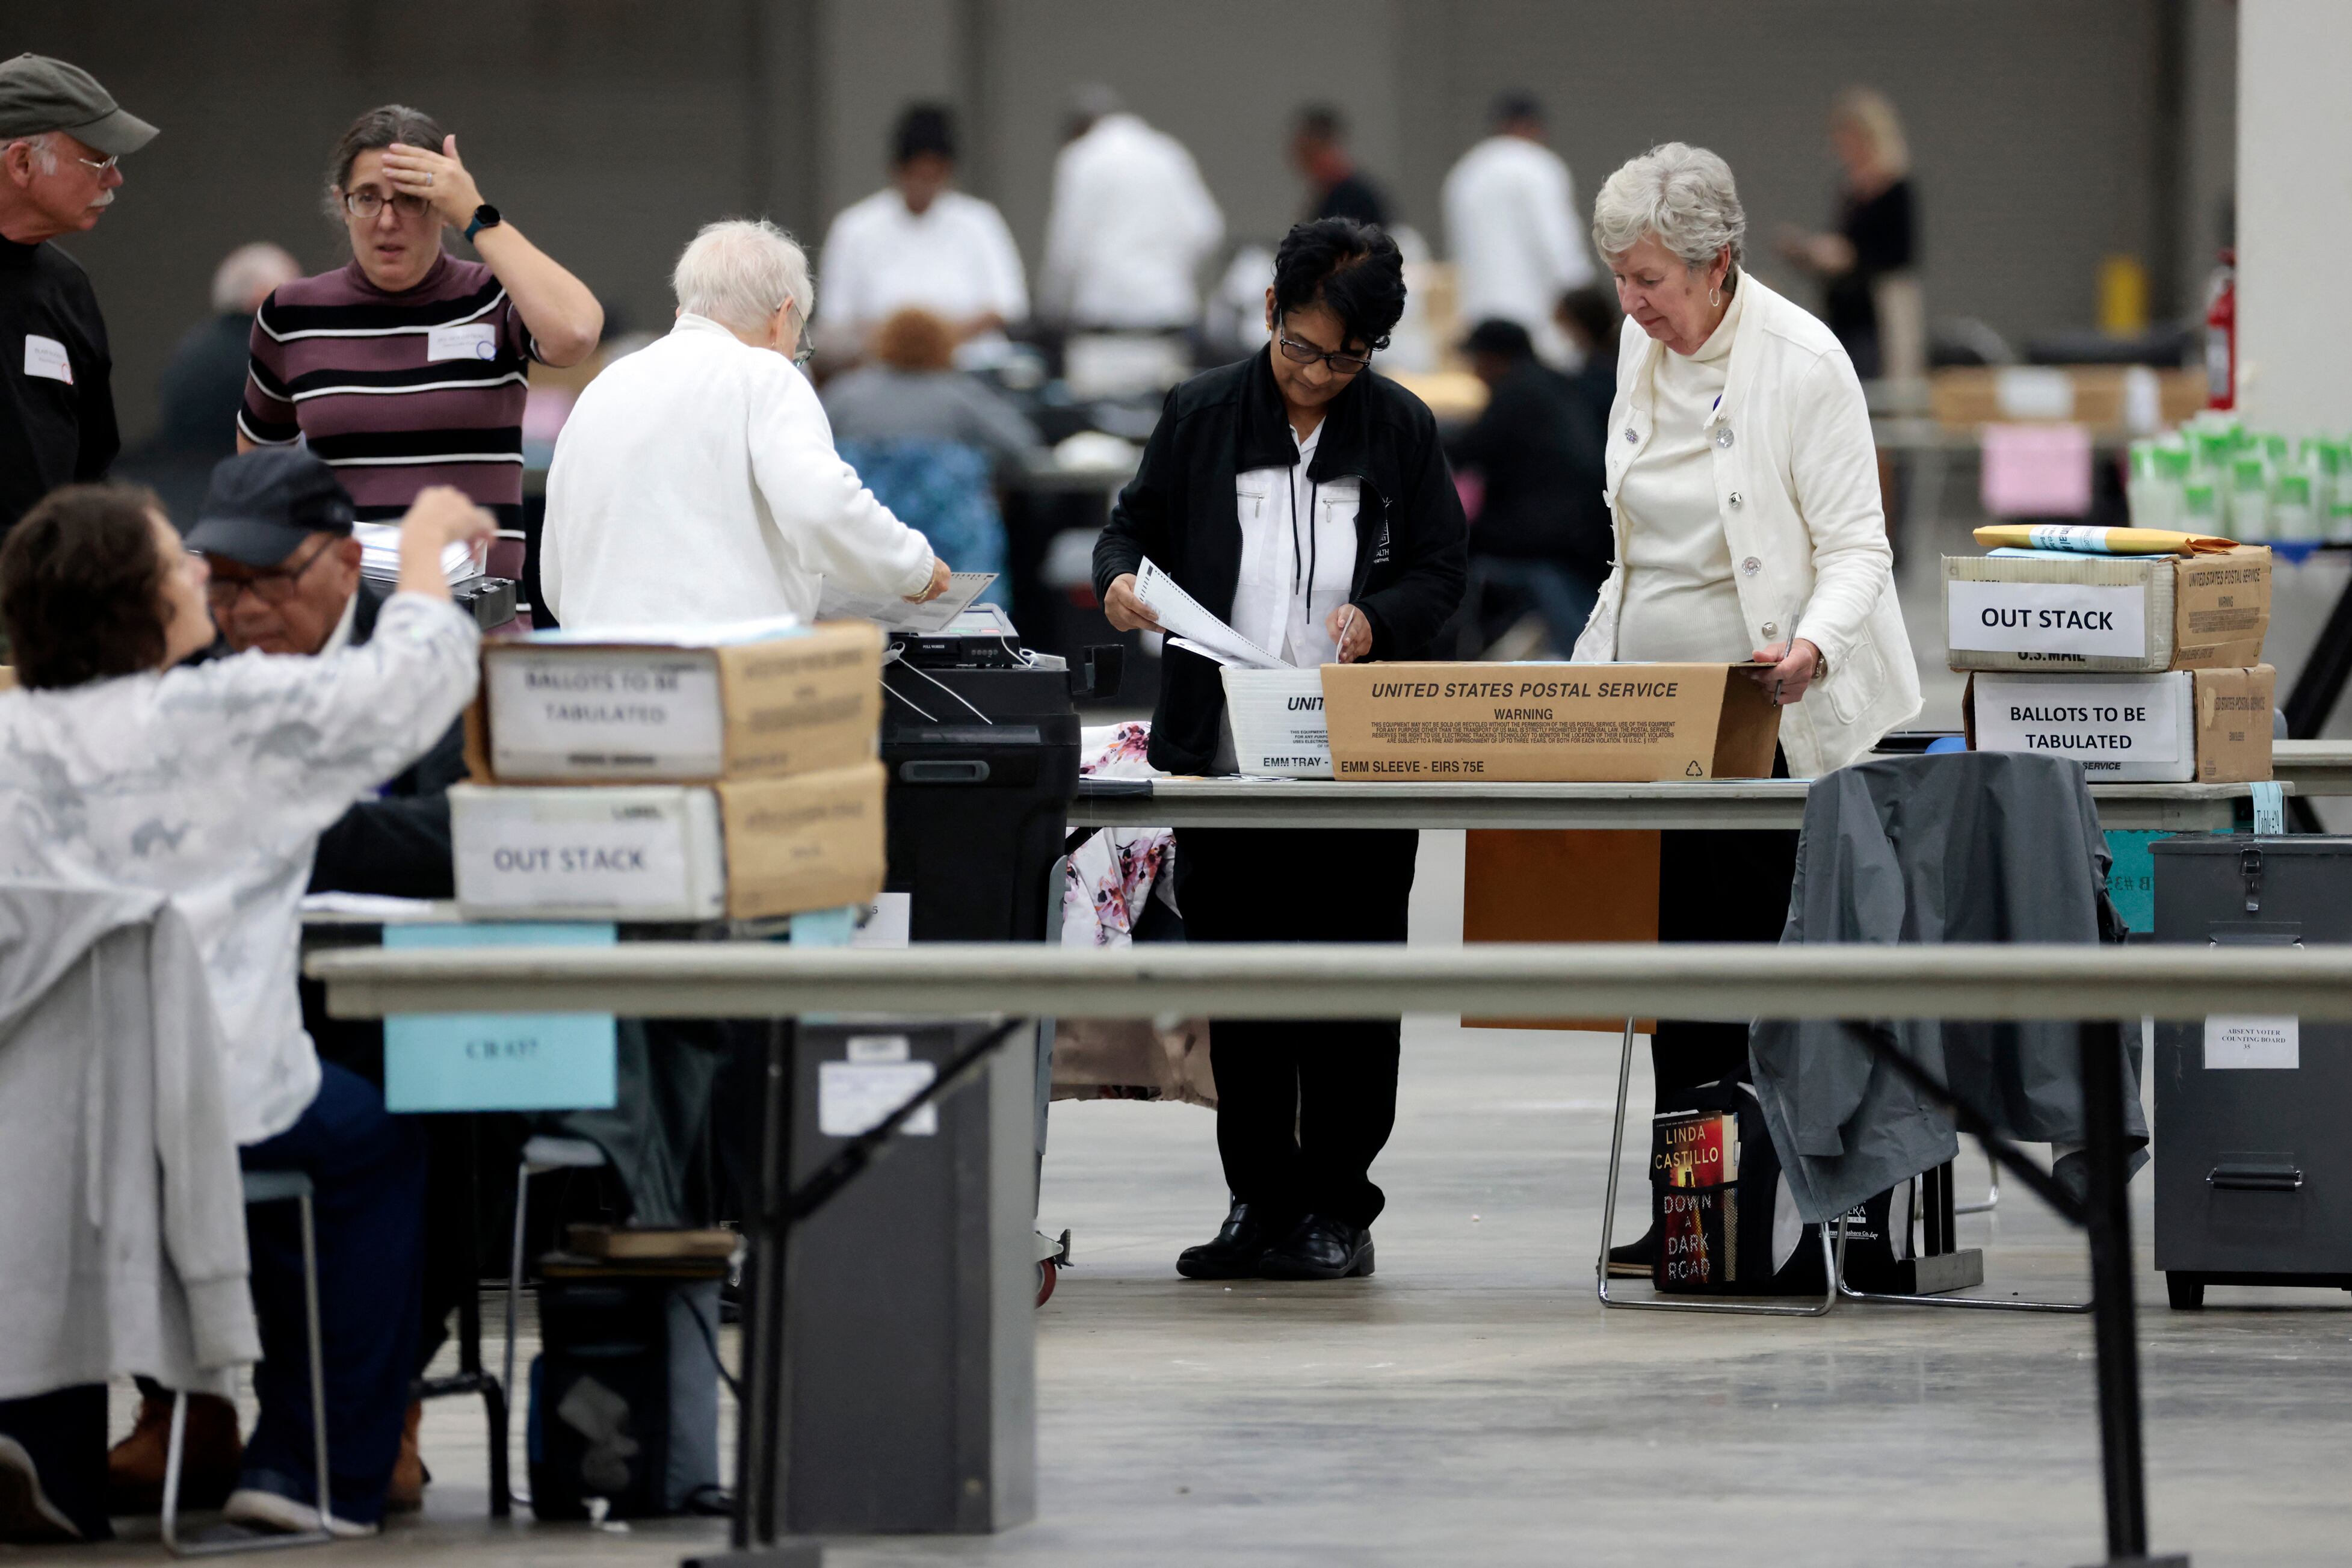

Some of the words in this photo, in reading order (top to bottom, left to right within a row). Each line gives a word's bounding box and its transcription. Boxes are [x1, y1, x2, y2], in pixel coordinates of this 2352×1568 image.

[2189, 572, 2205, 587] UNITED
[2206, 570, 2223, 585] STATES
[2225, 569, 2242, 585] POSTAL
[2242, 568, 2261, 583] SERVICE
[1981, 608, 2032, 628] OUT
[2039, 610, 2113, 631] STACK
[525, 671, 614, 691] BALLOTS
[622, 673, 649, 691] TO
[654, 673, 679, 693] BE
[1372, 683, 1439, 697] UNITED
[1444, 683, 1514, 697] STATES
[1520, 683, 1591, 697] POSTAL
[1597, 683, 1678, 697] SERVICE
[545, 703, 667, 721] TABULATED
[1287, 697, 1324, 711] UNIT
[1494, 709, 1553, 720] WARNING
[2010, 706, 2088, 722] BALLOTS
[2093, 708, 2118, 722] TO
[2124, 708, 2146, 722] BE
[2025, 734, 2132, 749] TABULATED
[1264, 758, 1289, 767] EMM
[1292, 758, 1321, 767] TRAY
[1341, 761, 1369, 772] EMM
[1372, 761, 1420, 773] SLEEVE
[1431, 761, 1460, 773] EIRS
[1463, 761, 1484, 772] 75E
[2082, 762, 2121, 770] SERVICE
[493, 847, 550, 872] OUT
[560, 847, 644, 872] STACK
[1666, 1125, 1706, 1144] LINDA
[1655, 1147, 1718, 1170] CASTILLO
[1664, 1193, 1712, 1214] DOWN
[1848, 1205, 1866, 1217] ERA
[1685, 1215, 1692, 1227] A
[1668, 1233, 1709, 1255] DARK
[1668, 1258, 1710, 1280] ROAD
